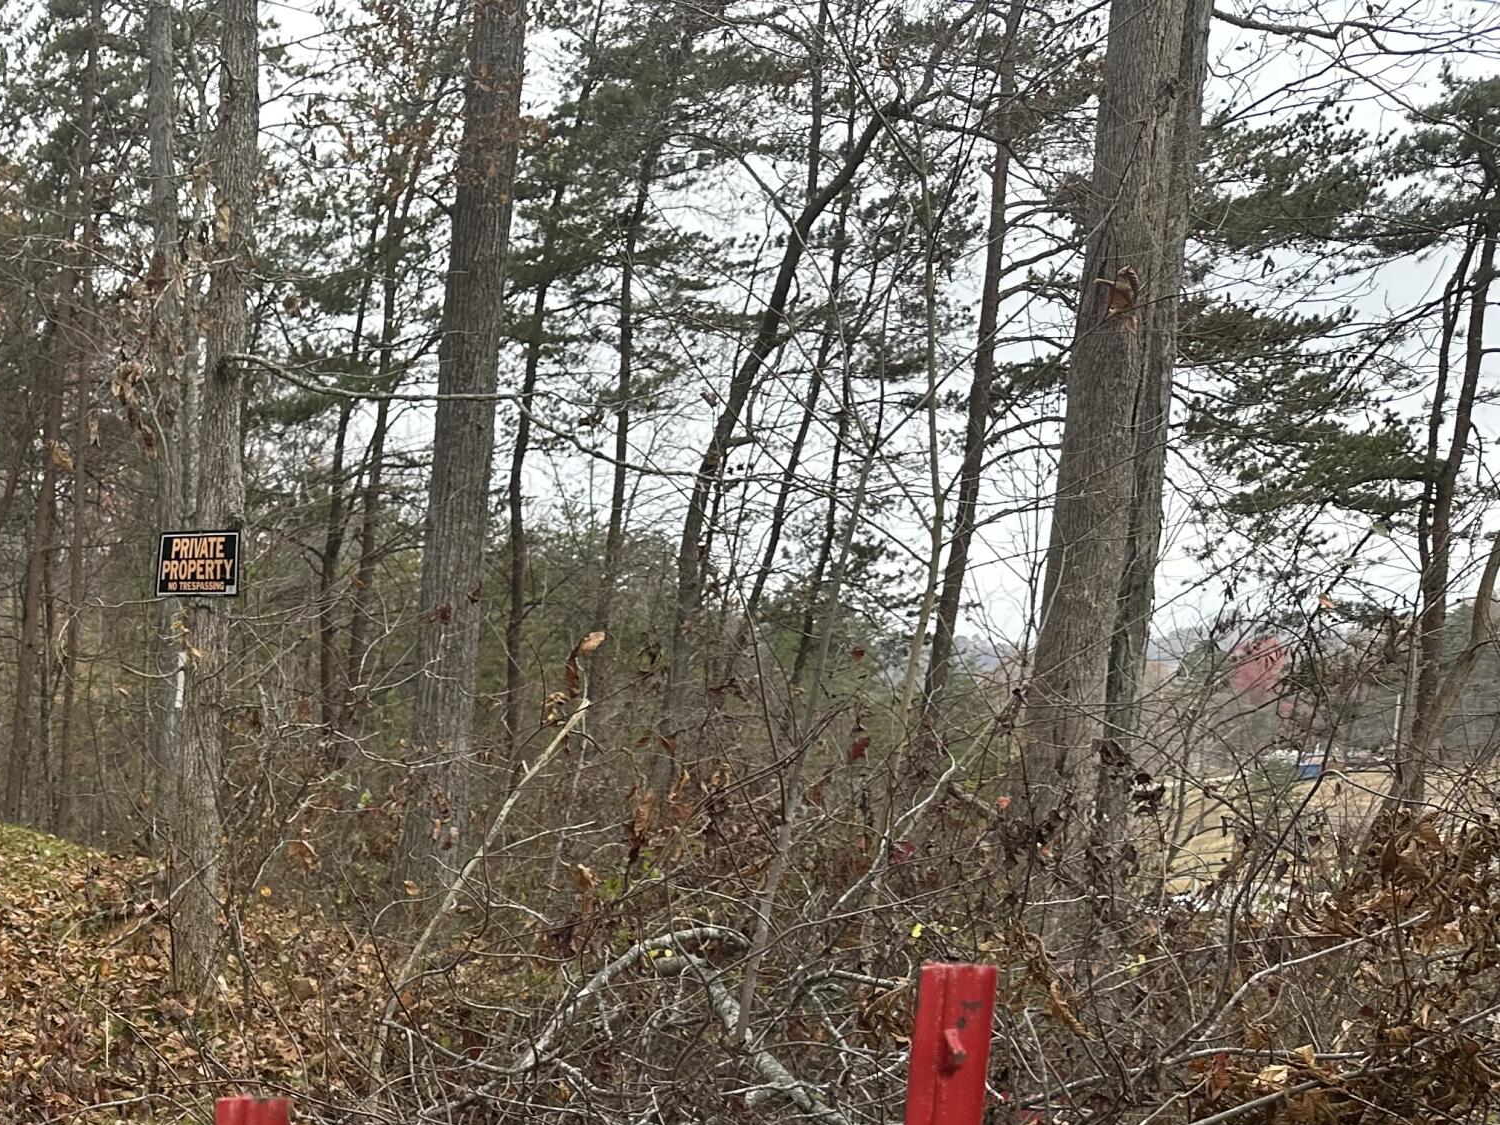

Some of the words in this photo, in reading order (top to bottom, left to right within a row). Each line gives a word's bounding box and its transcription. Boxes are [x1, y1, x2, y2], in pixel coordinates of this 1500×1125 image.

[171, 536, 226, 559] PRIVATE
[161, 559, 234, 580] PROPERTY
[167, 581, 178, 591] NO
[179, 581, 225, 591] TRESPASSING
